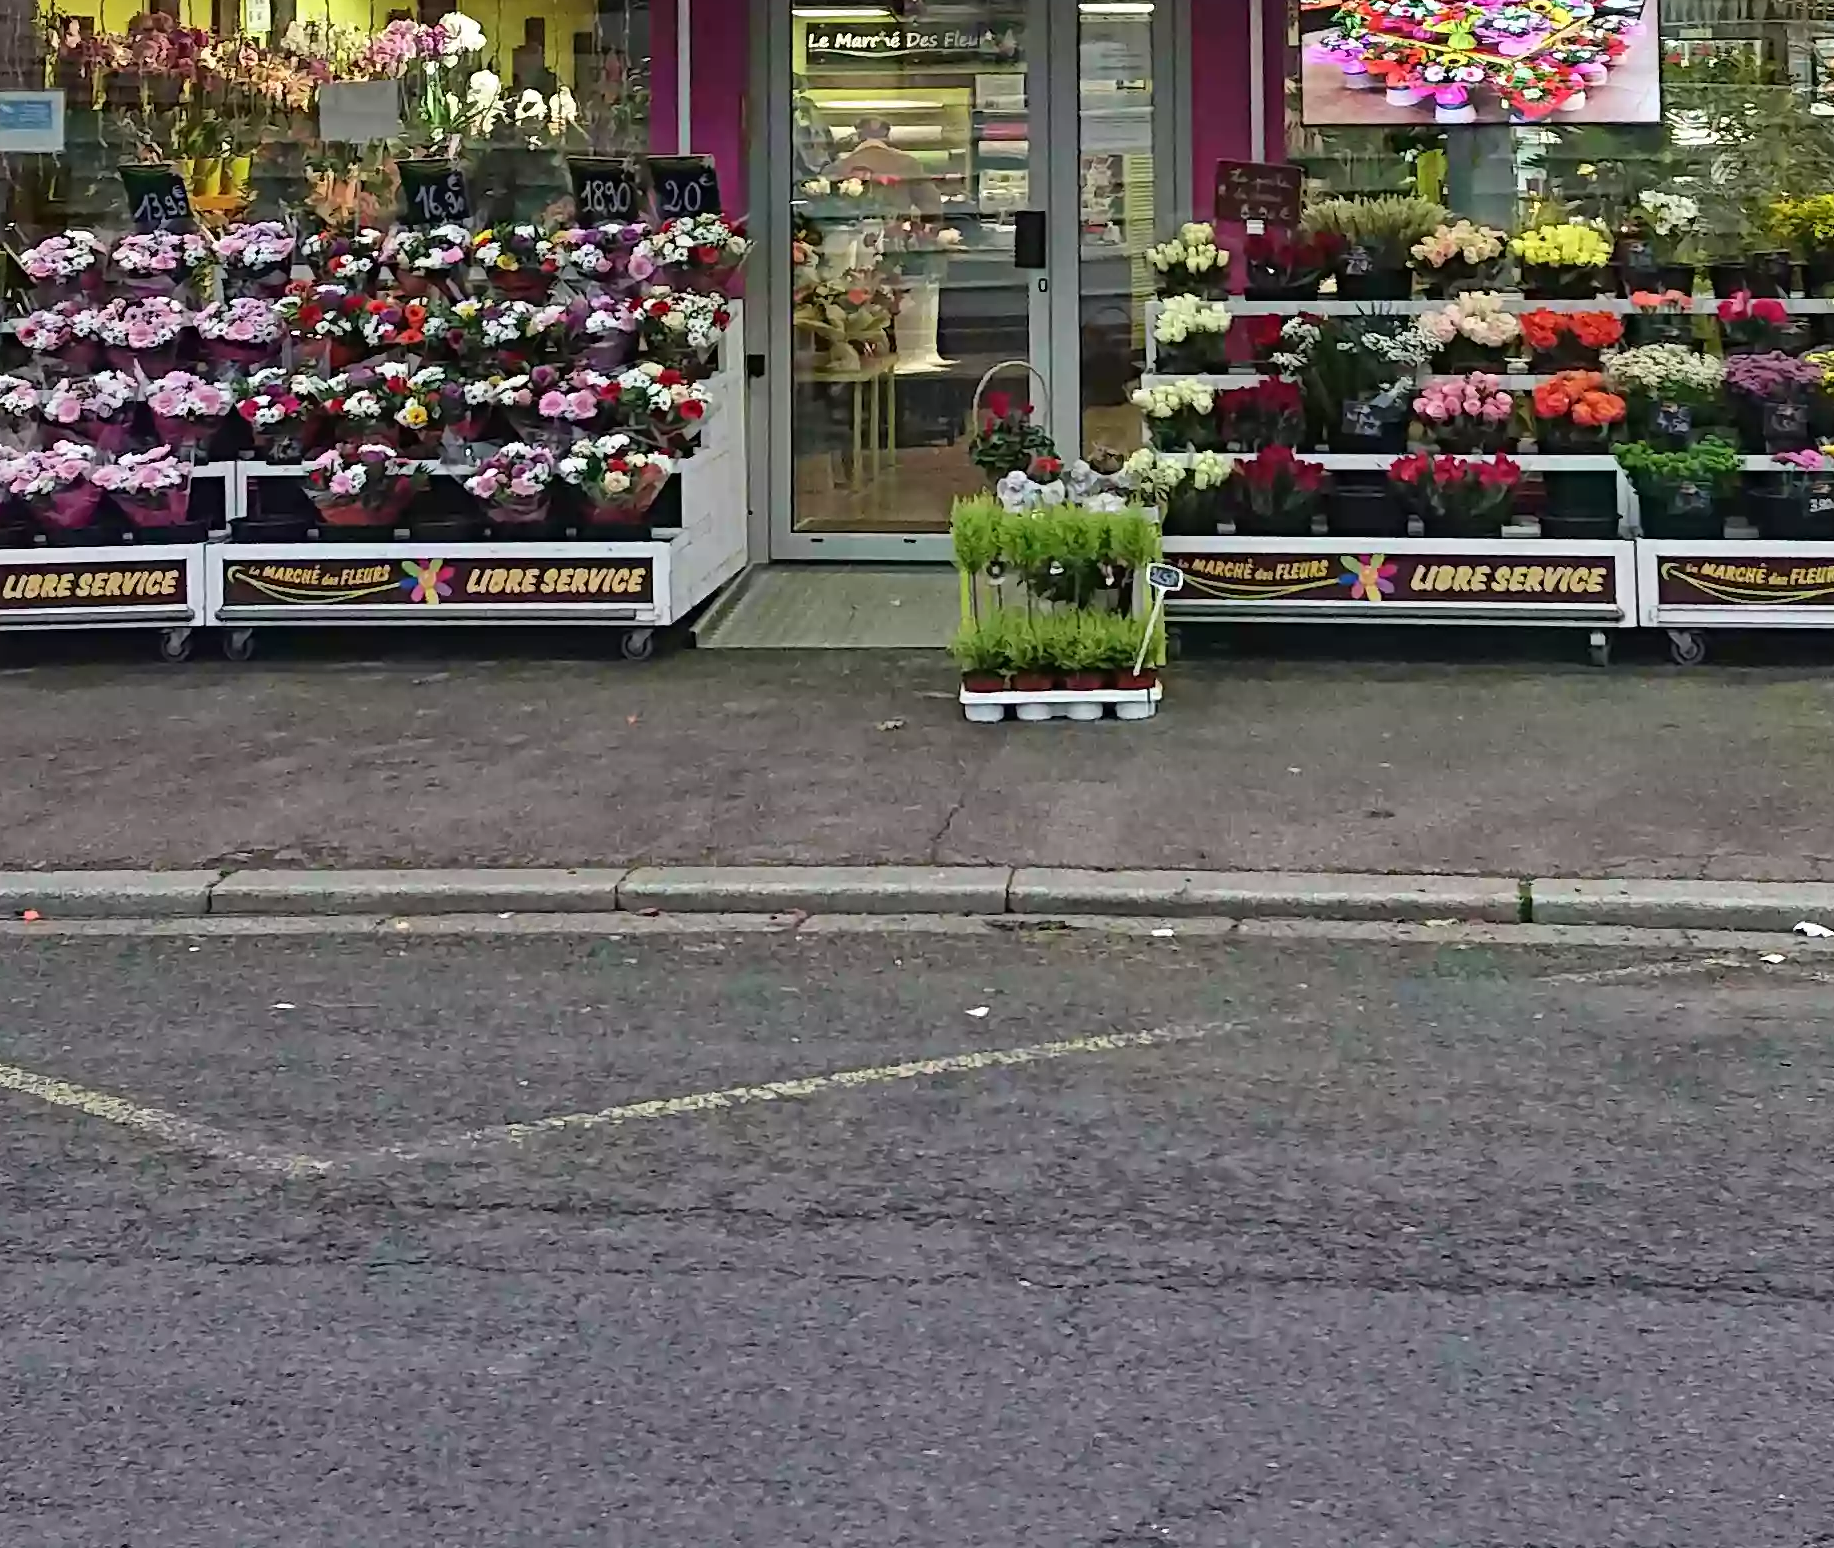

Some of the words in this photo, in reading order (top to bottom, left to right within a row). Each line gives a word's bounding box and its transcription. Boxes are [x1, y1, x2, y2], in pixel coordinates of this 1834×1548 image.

[808, 32, 830, 48] Le
[906, 32, 938, 48] Des
[944, 30, 995, 48] Fleu
[262, 564, 322, 586] MARCHÉ
[339, 563, 391, 586] FLEURS
[1191, 557, 1254, 579] MARCHÉ
[1275, 559, 1329, 580] FLEURS
[1410, 564, 1487, 592] LIBRE
[1490, 564, 1607, 594] SERVICE
[1699, 561, 1767, 583] MARCHÉ
[1, 571, 73, 600] LIBRE
[75, 568, 179, 598] SERVICE
[465, 567, 538, 595] LIBRE
[540, 566, 647, 594] SERVICE
